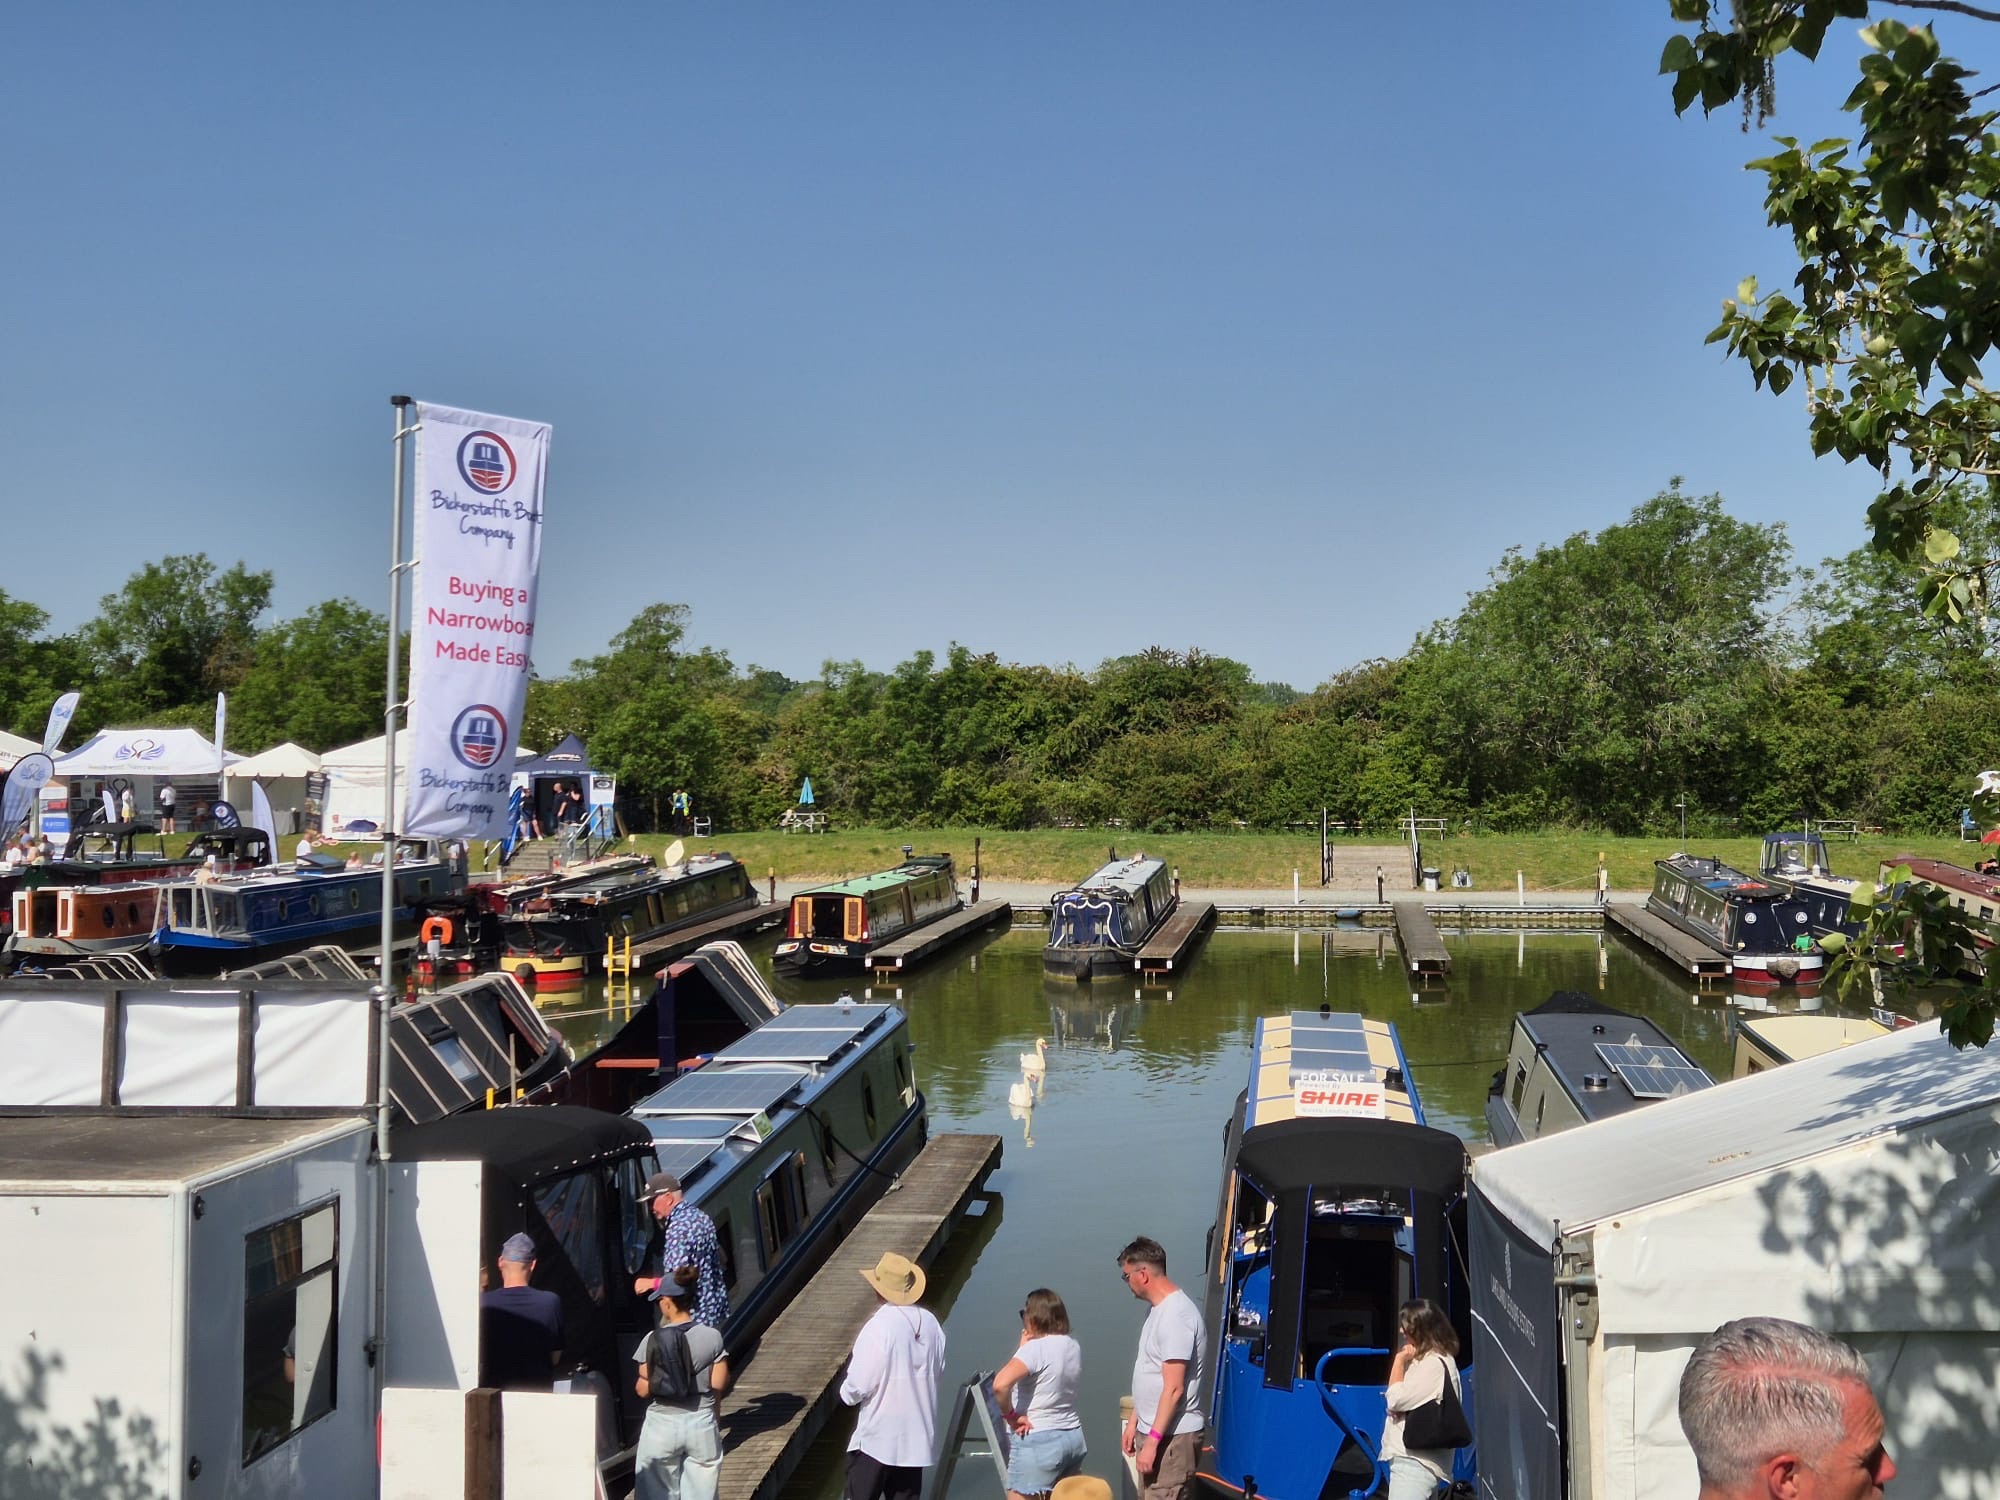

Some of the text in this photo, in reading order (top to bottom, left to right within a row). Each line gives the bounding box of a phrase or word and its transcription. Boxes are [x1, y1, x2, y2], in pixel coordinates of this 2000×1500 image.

[430, 489, 510, 520] Bickerstaffe
[460, 515, 515, 549] Company
[449, 576, 528, 607] Buying a
[428, 607, 534, 636] Narrowboa
[436, 640, 530, 673] Made Easy
[445, 792, 494, 823] Company
[1301, 1072, 1366, 1083] FOR SALE
[1299, 1090, 1379, 1107] SHIRE
